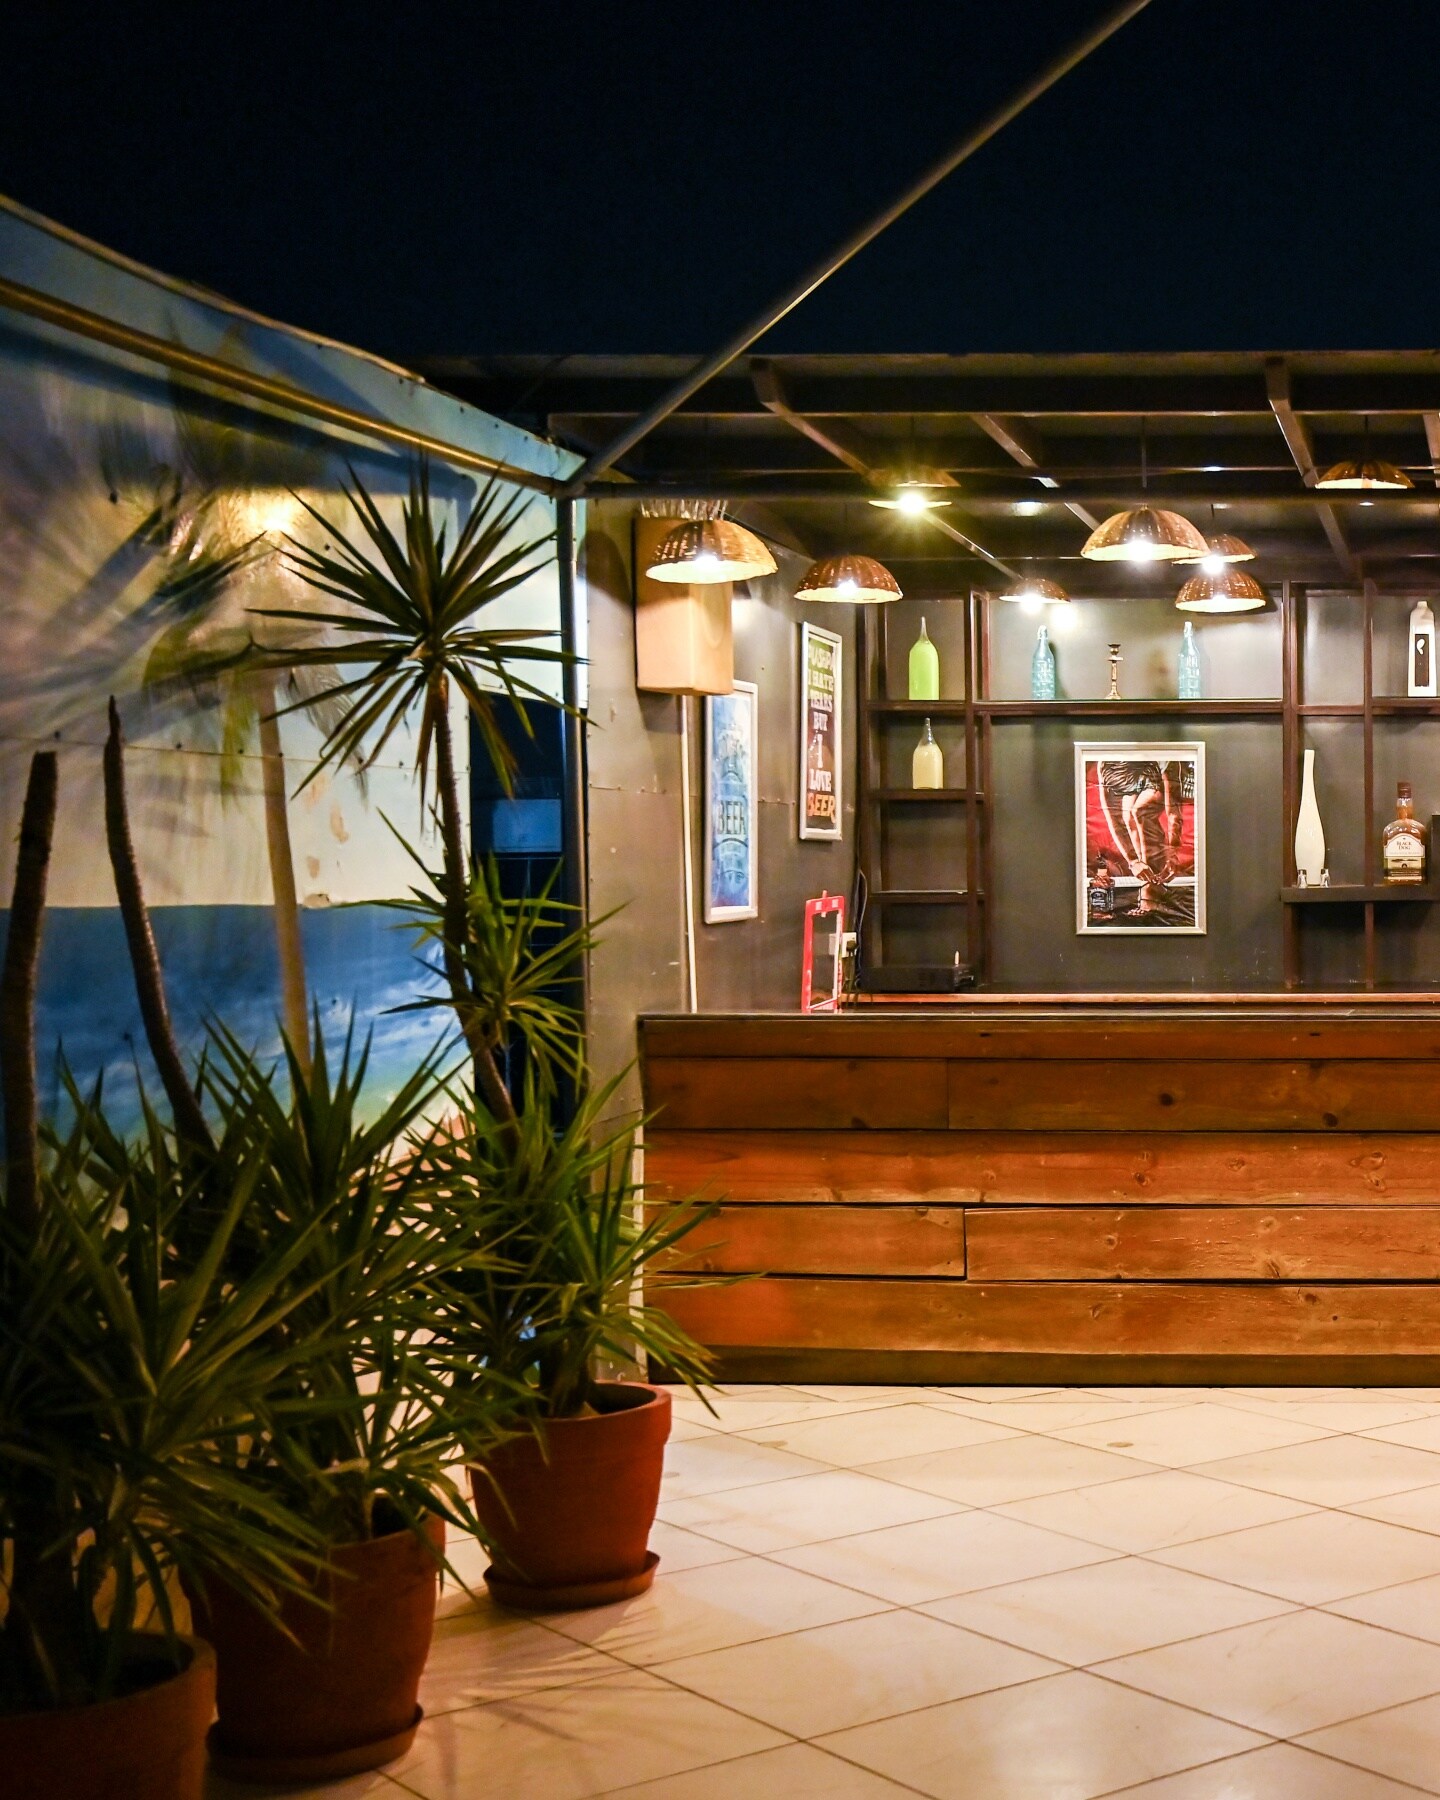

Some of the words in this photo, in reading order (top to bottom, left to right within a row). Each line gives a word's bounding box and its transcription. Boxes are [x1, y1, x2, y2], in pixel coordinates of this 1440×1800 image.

[813, 671, 834, 692] HATE
[813, 712, 828, 731] BUT
[817, 733, 823, 768] I
[809, 768, 832, 792] LOVE
[718, 800, 747, 835] BEER
[808, 792, 835, 823] BEER
